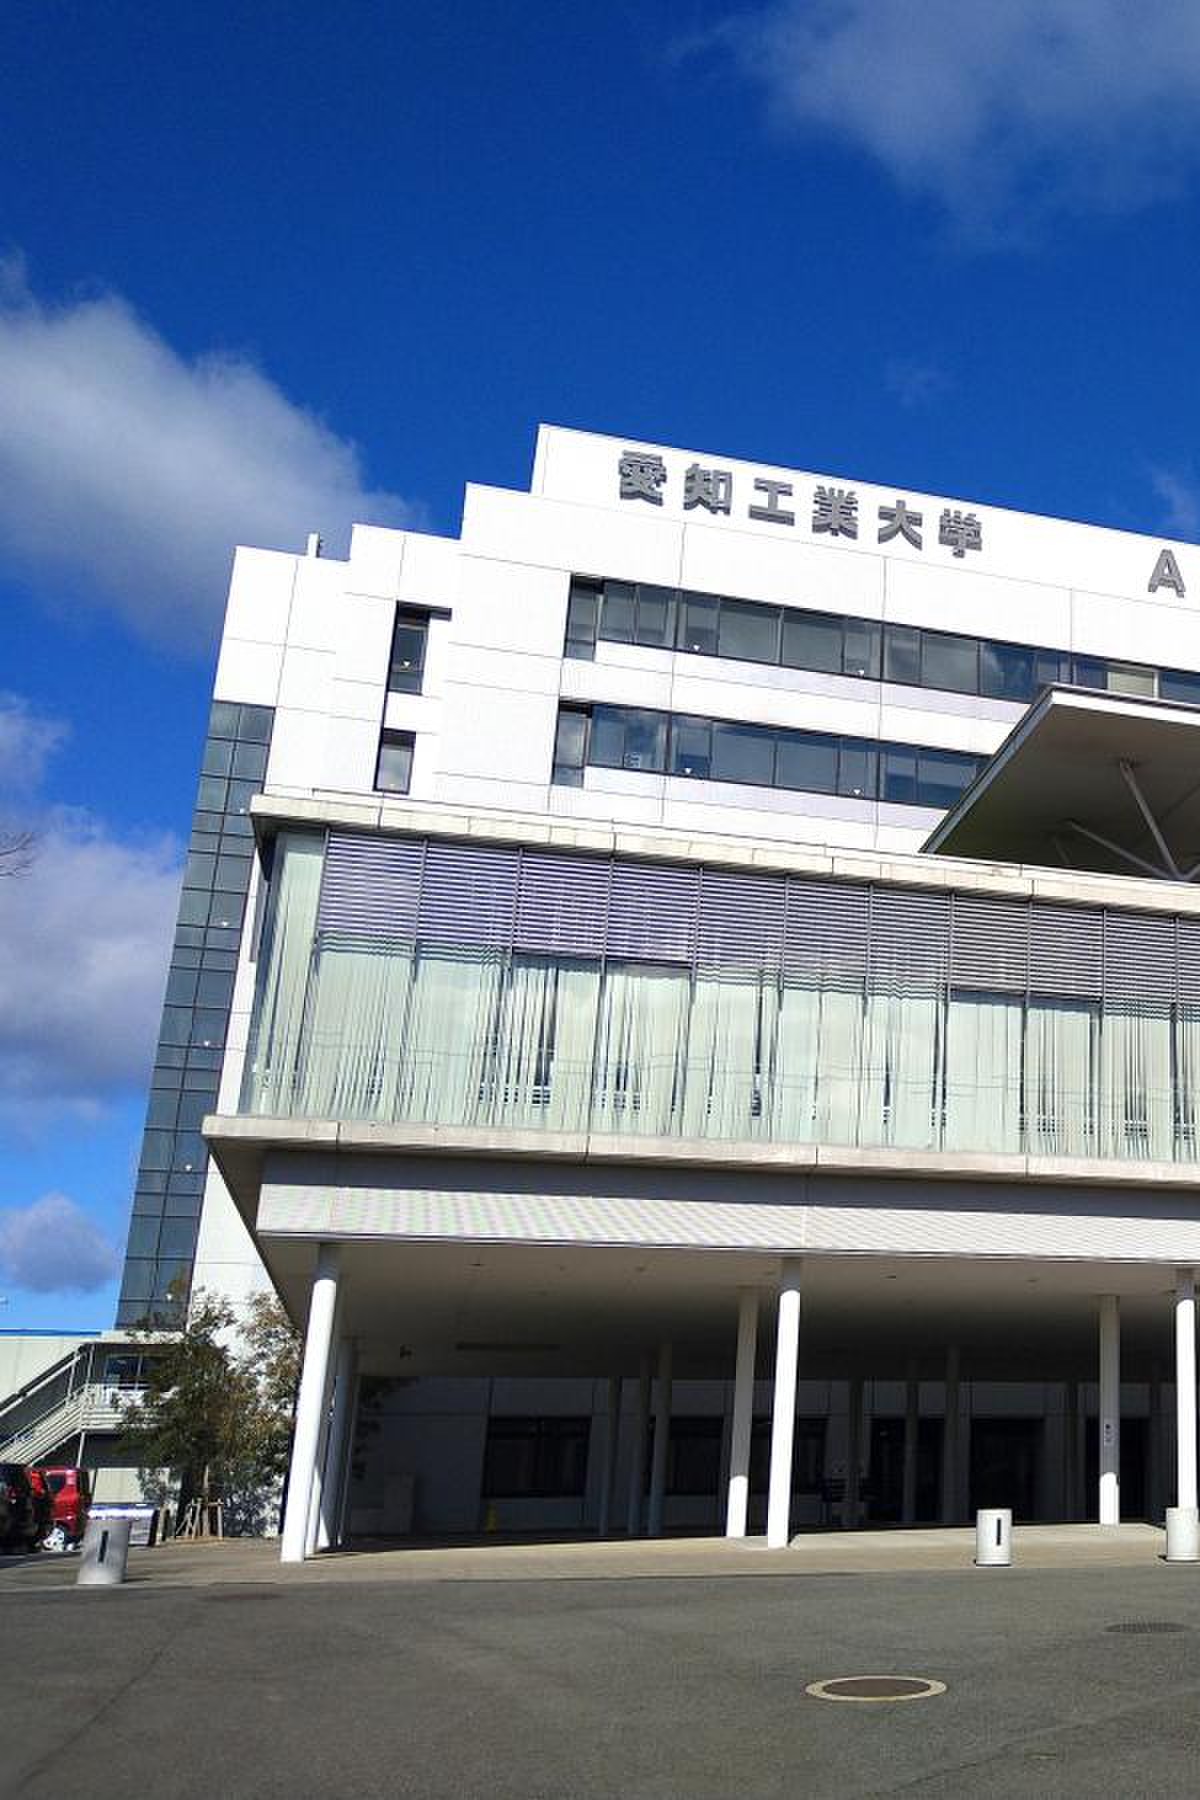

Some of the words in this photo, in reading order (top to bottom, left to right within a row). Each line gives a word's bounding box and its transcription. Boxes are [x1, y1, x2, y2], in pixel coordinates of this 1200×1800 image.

[618, 450, 983, 558] 愛知工業大学
